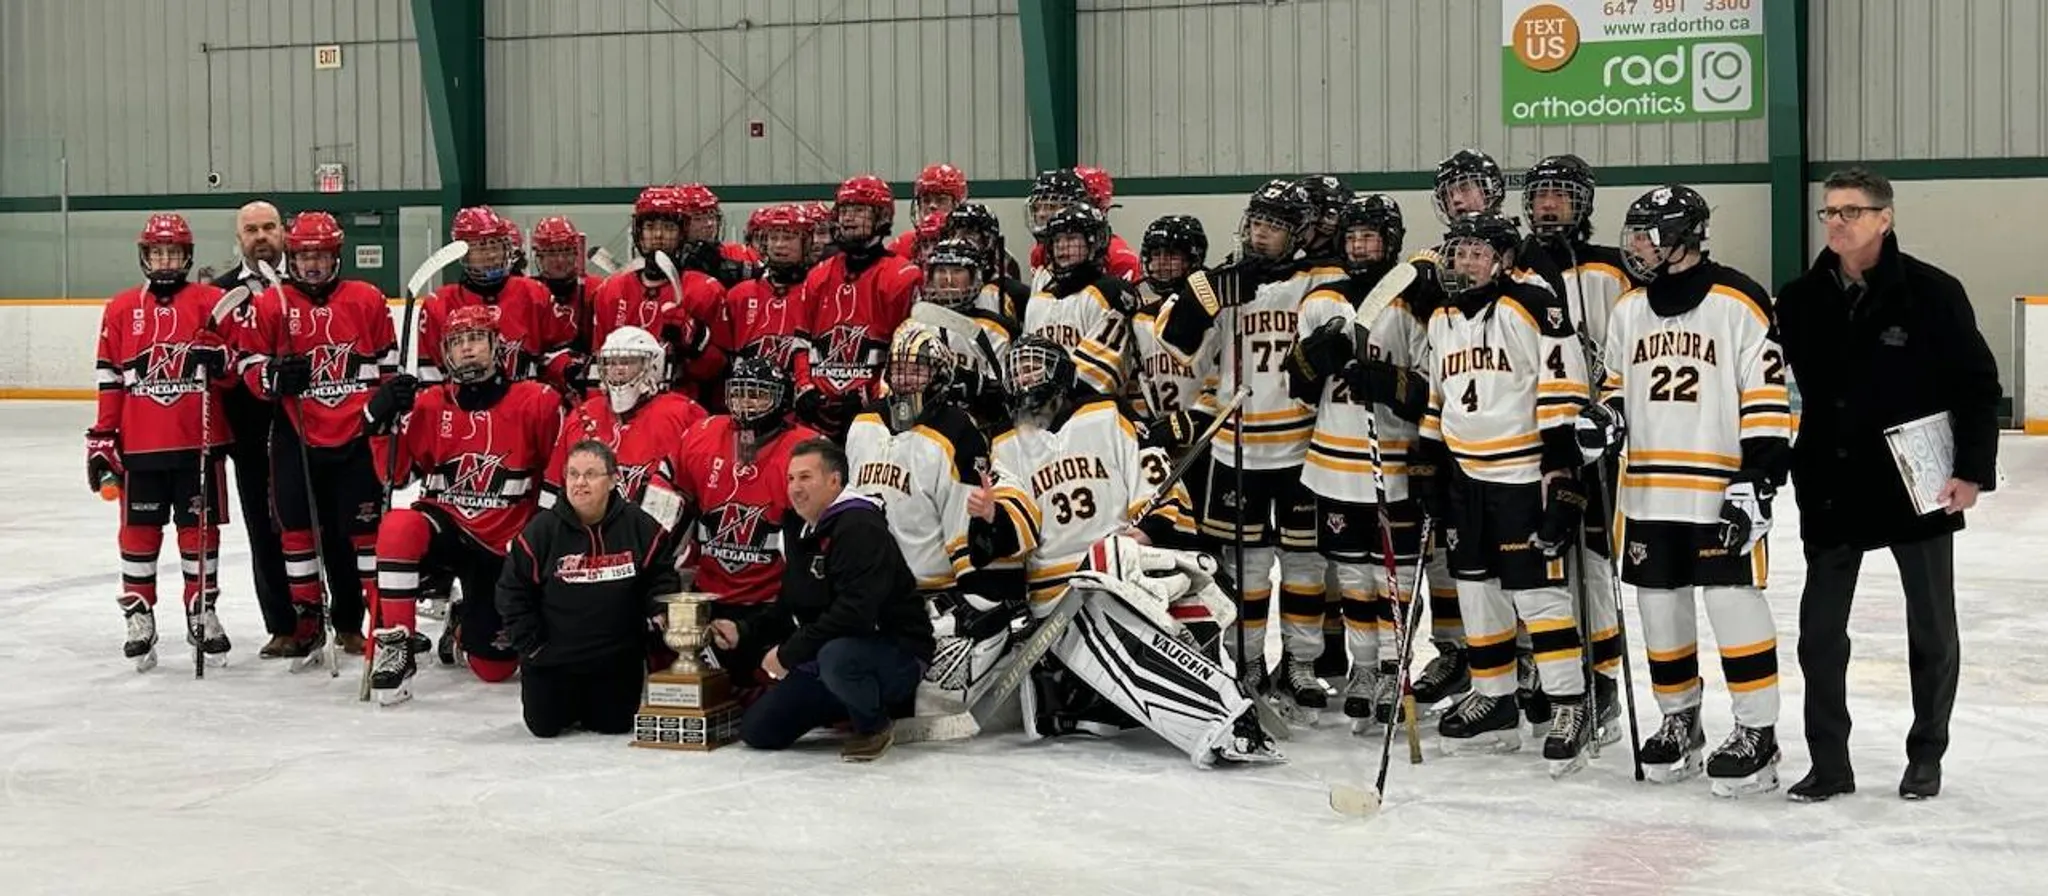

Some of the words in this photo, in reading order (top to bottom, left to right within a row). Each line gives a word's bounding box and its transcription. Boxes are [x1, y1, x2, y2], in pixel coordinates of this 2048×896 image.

[1603, 0, 1637, 15] 647
[1524, 18, 1567, 36] TEXT
[319, 49, 337, 65] EXIT
[1526, 37, 1566, 60] US
[1603, 45, 1686, 87] rad
[1512, 92, 1686, 119] orthodontics
[1243, 310, 1300, 336] UROR
[1252, 340, 1291, 373] 77
[1547, 344, 1567, 379] 4
[1763, 349, 1786, 385] 2
[300, 383, 368, 398] ENEGADES
[1460, 378, 1479, 413] 4
[1650, 365, 1700, 403] 22
[856, 461, 912, 497] AURORA
[1030, 456, 1109, 500] AURORA
[1050, 486, 1096, 525] 33
[1152, 633, 1215, 681] VAUGHN
